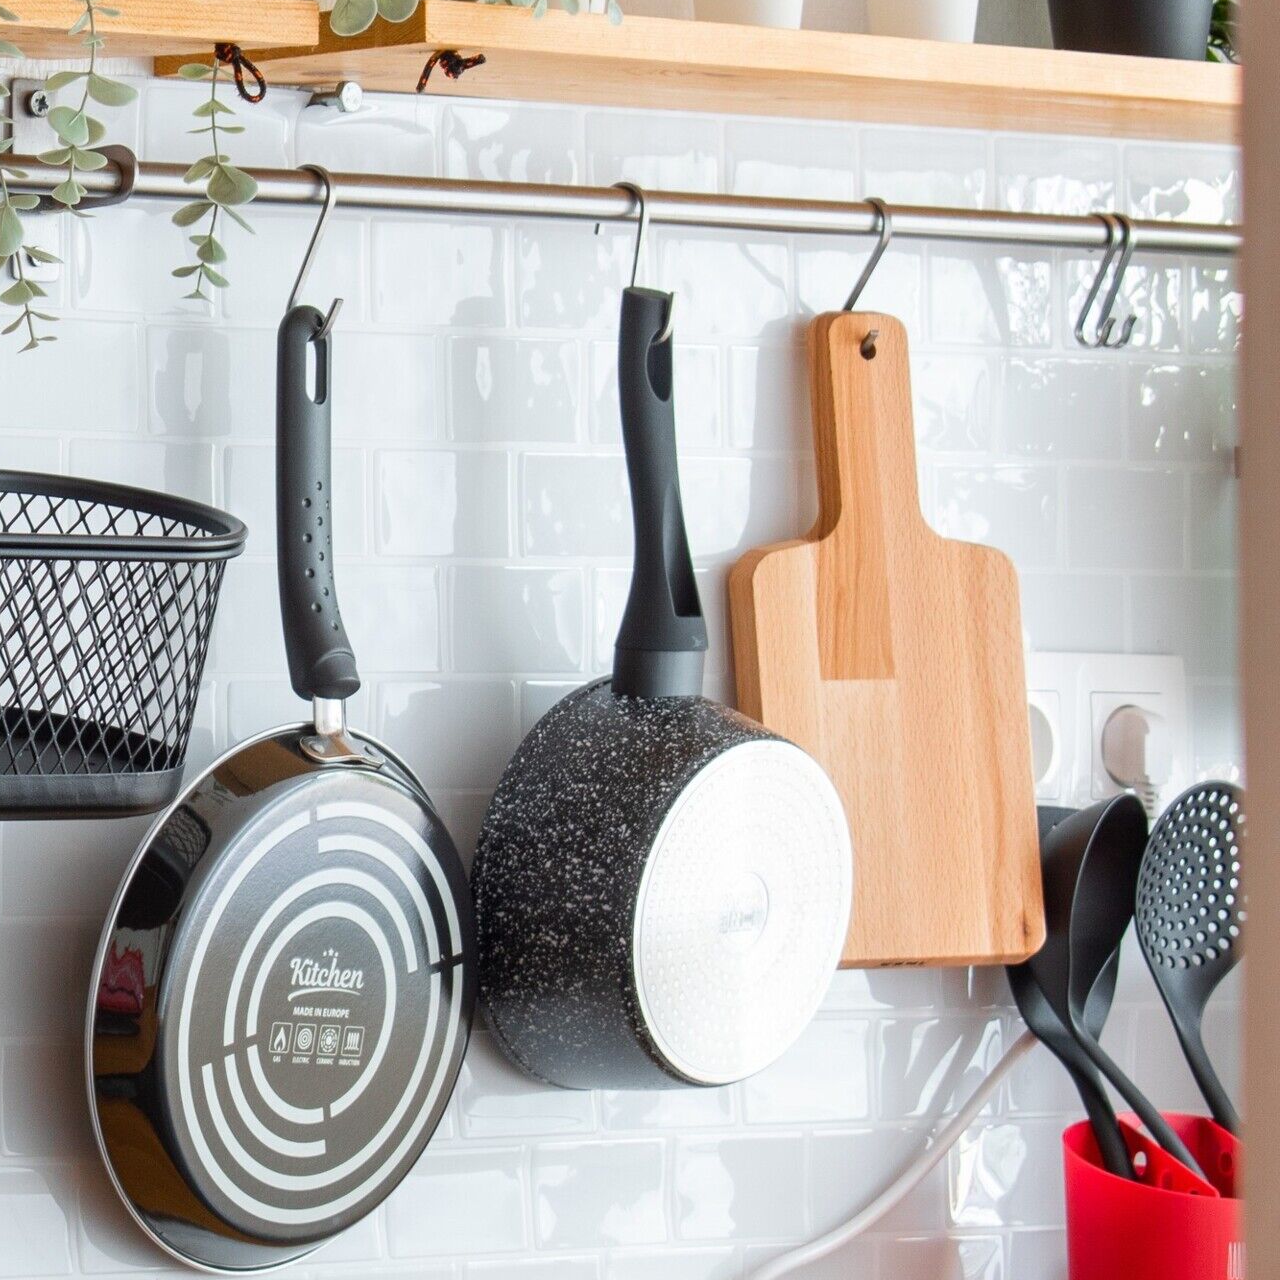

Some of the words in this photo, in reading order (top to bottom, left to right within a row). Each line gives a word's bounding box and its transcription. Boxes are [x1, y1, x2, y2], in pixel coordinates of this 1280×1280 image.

[290, 957, 364, 989] Kitchen
[292, 1006, 313, 1016] MADE
[314, 1007, 322, 1017] IN
[323, 1008, 350, 1018] EUROPE
